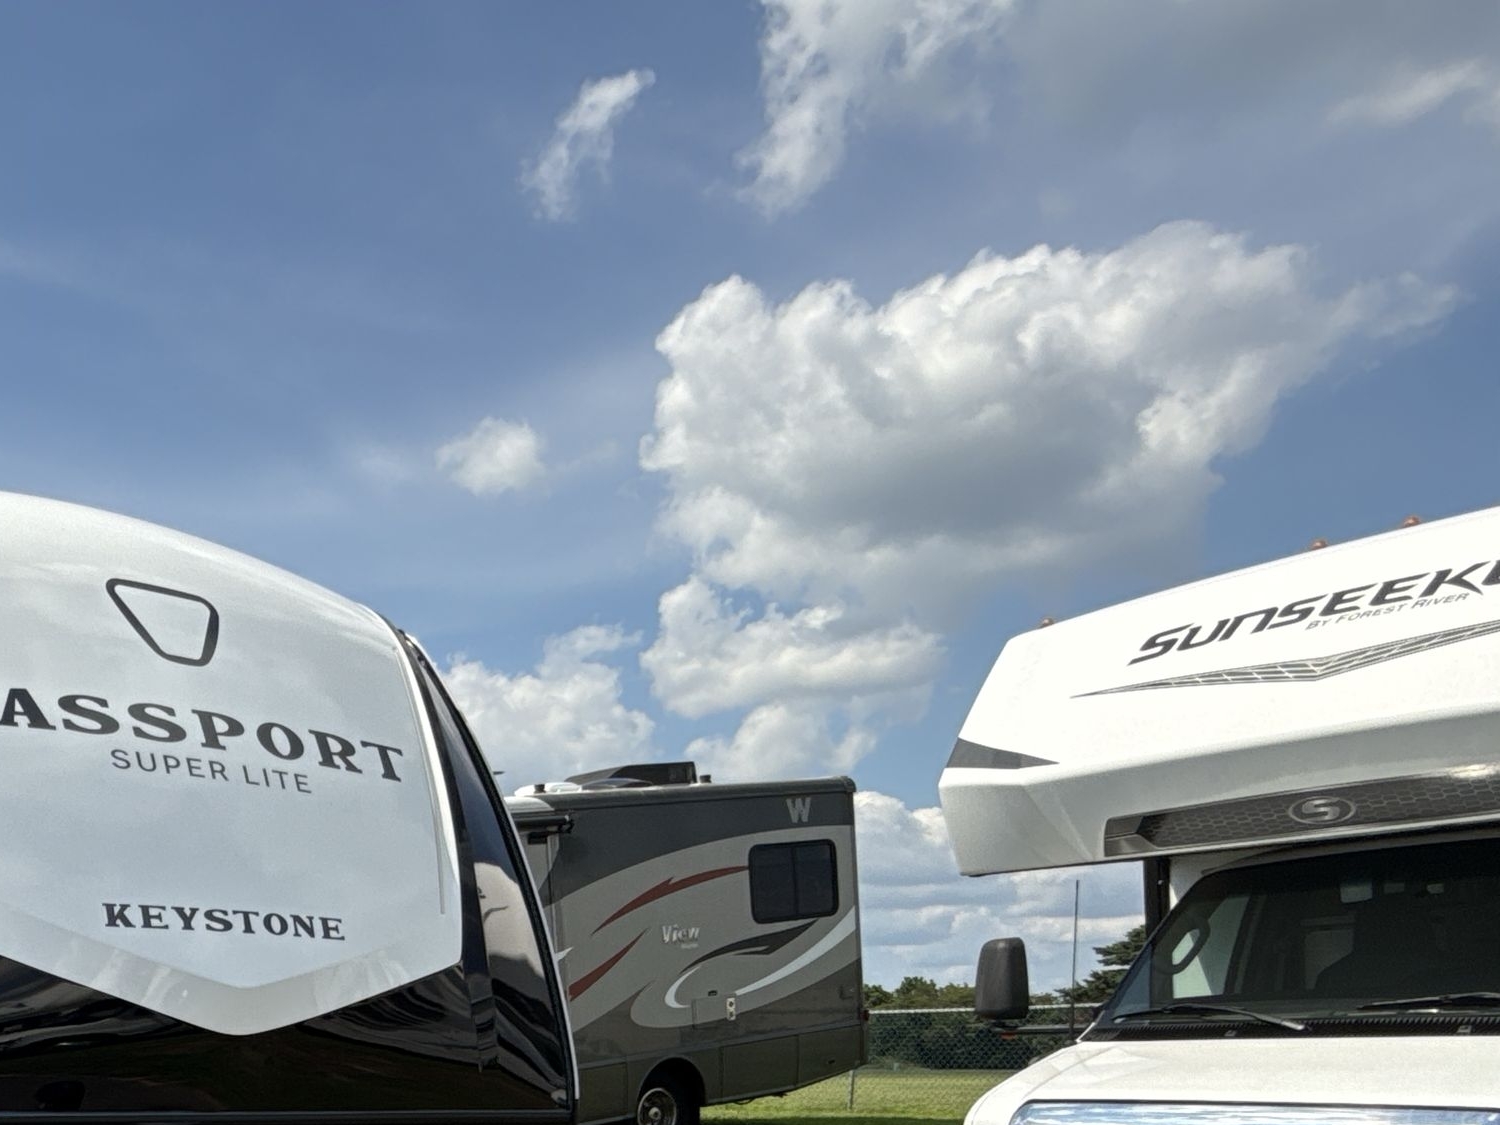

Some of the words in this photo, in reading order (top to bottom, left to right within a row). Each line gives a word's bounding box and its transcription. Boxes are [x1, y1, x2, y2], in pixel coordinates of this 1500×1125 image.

[1304, 618, 1332, 631] BY
[1334, 602, 1408, 624] FOREST
[1411, 592, 1470, 610] RIVER
[110, 748, 230, 782] SUPER
[243, 764, 313, 794] LITE
[102, 902, 346, 941] KEYSTONE
